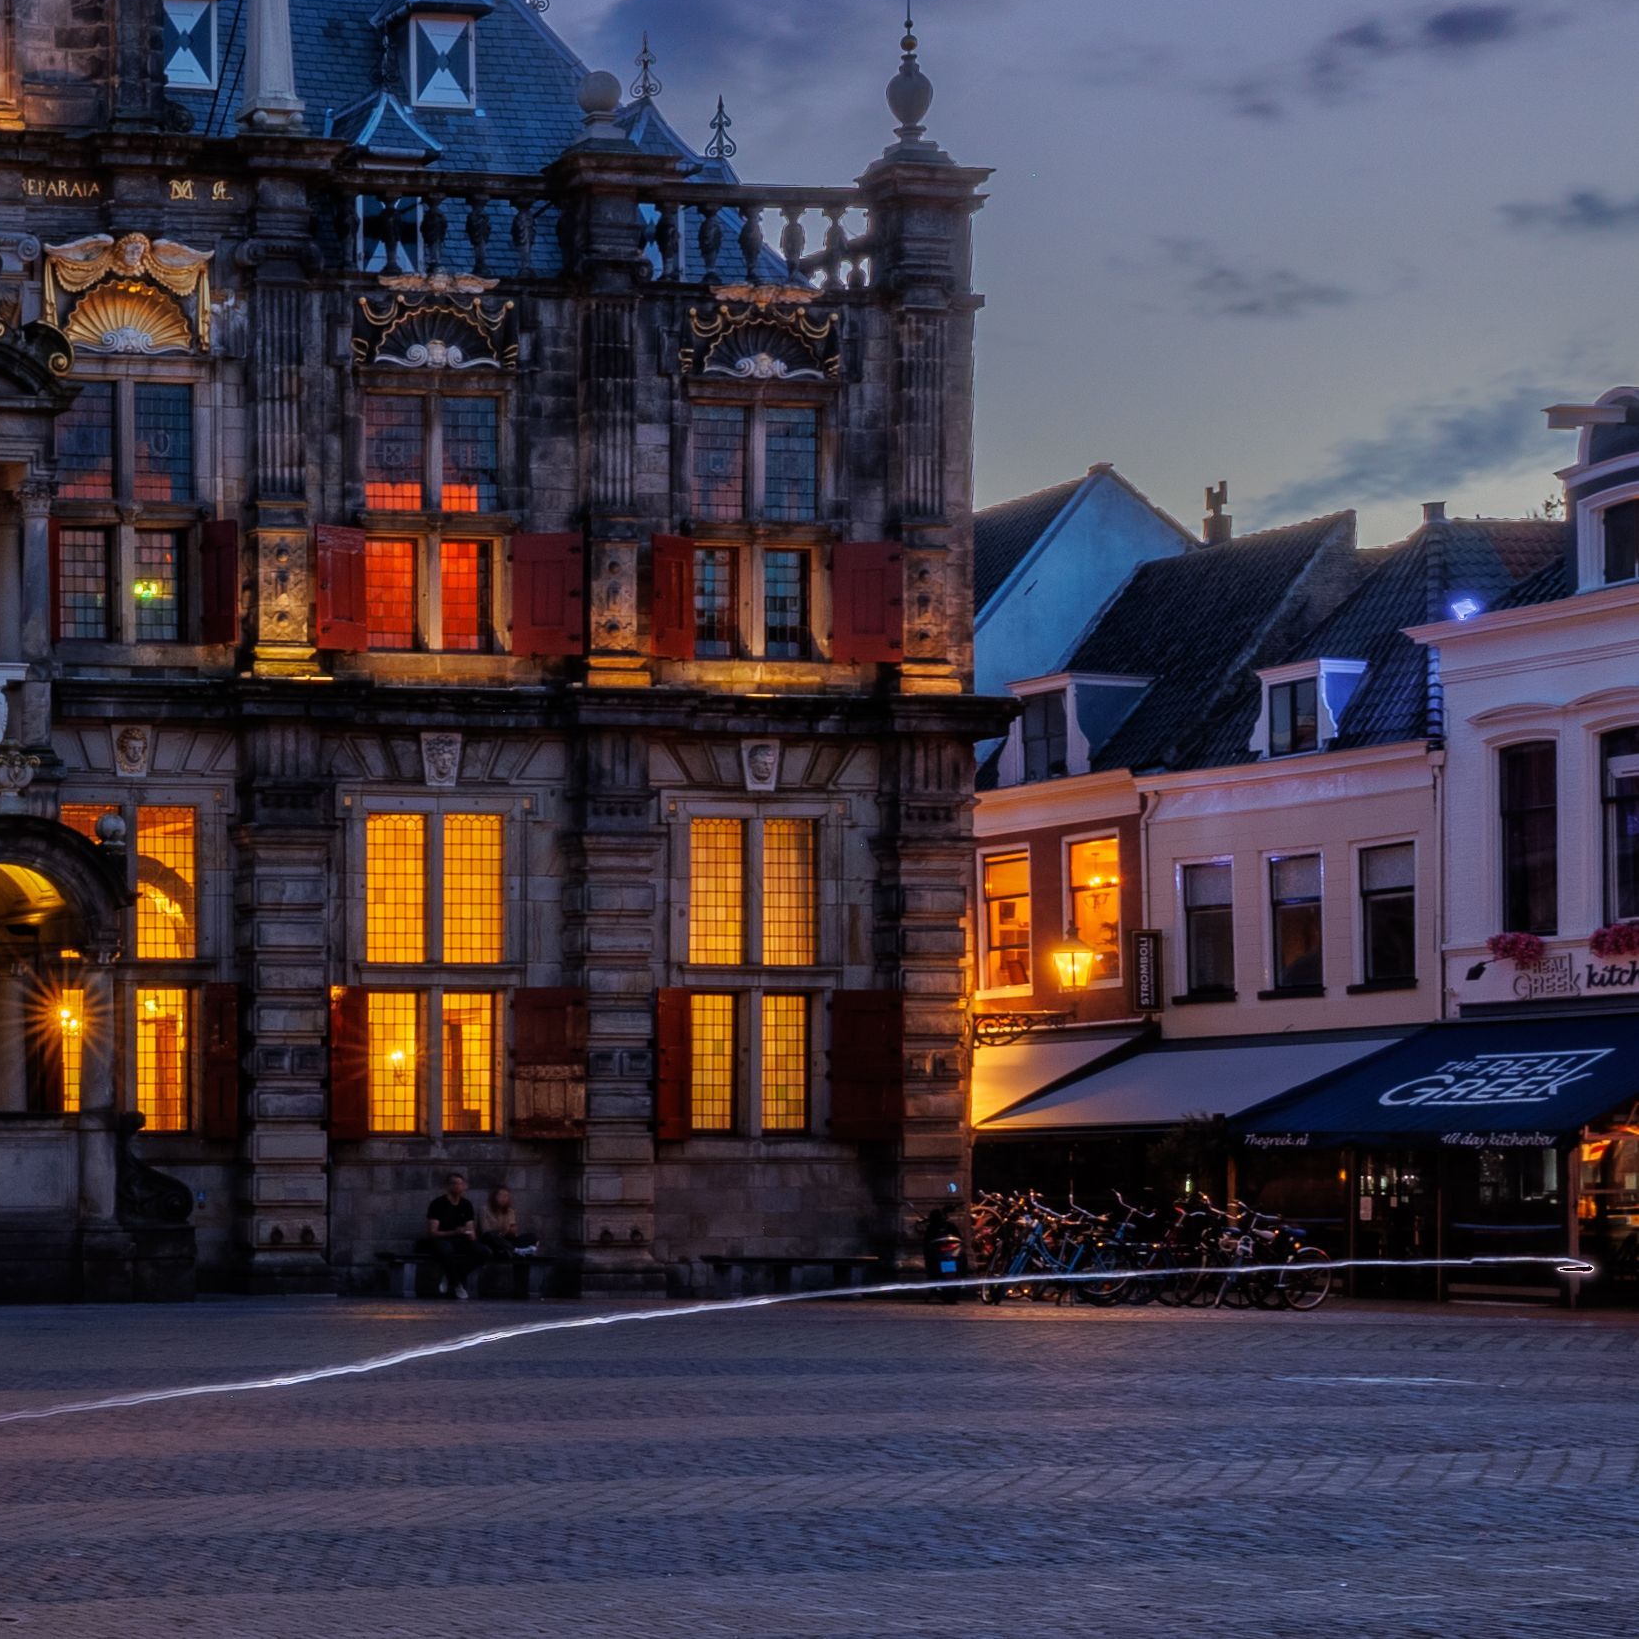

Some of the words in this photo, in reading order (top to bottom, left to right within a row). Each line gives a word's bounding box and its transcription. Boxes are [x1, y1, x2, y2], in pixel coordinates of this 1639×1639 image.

[1140, 937, 1149, 1005] STROMBOLI
[1436, 1060, 1481, 1072] THE
[1475, 1058, 1577, 1076] REAL
[1379, 1072, 1593, 1106] GREEK
[1461, 1132, 1487, 1149] day
